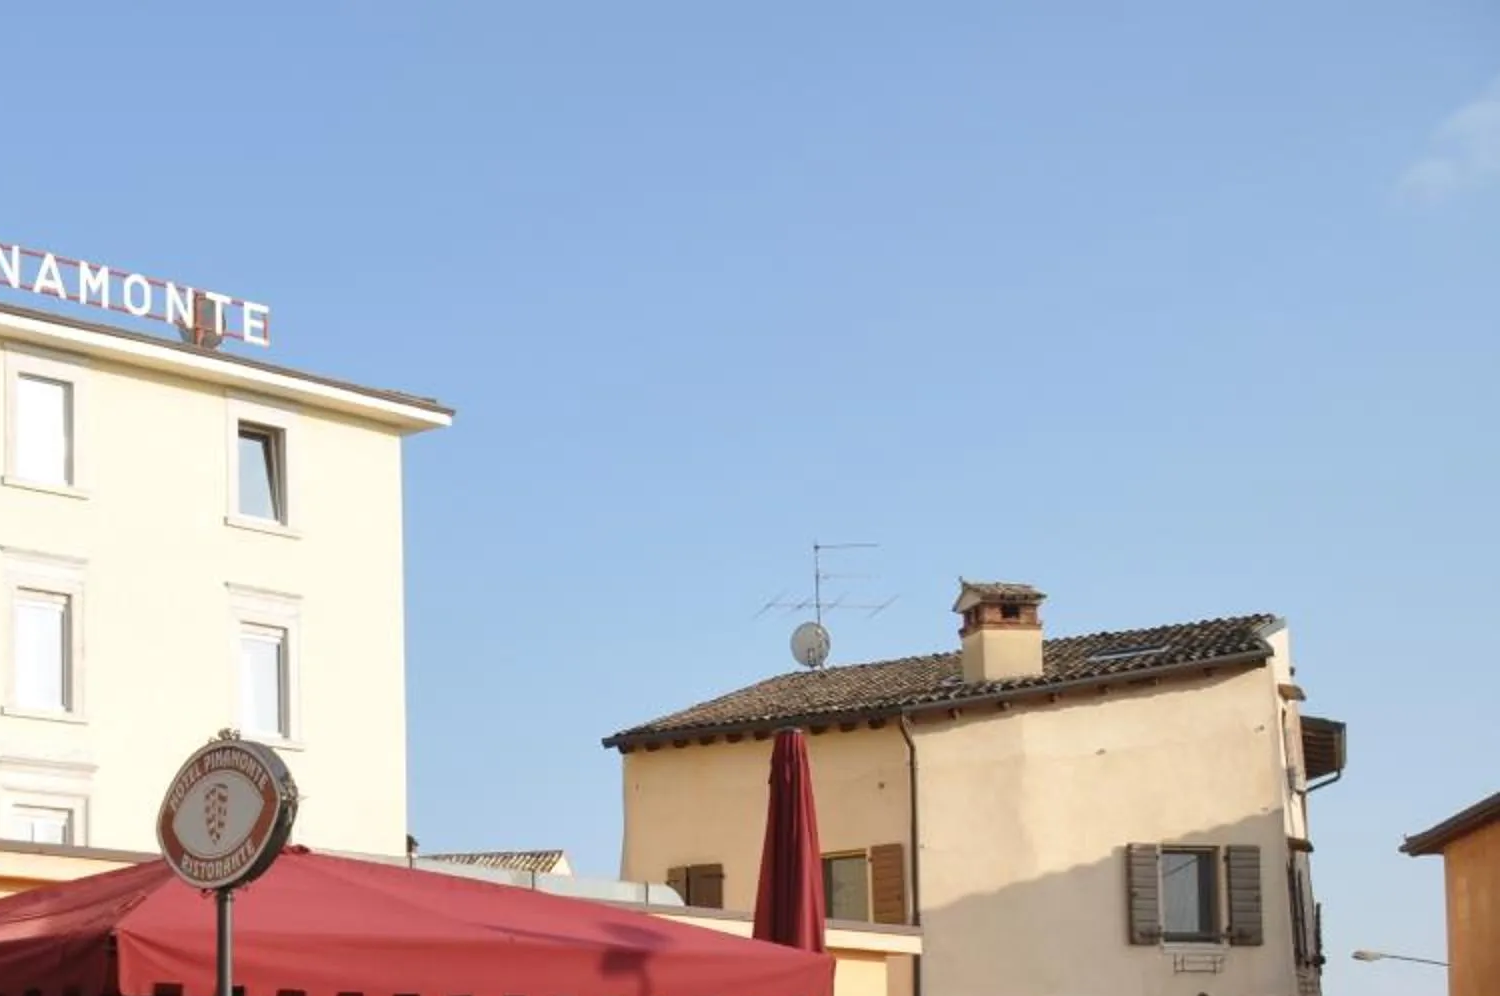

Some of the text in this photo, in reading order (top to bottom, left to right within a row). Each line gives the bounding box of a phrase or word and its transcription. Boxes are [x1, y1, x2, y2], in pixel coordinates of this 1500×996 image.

[169, 748, 269, 812] HOTEL PINAMONTE
[180, 838, 256, 879] RISTORANTE
